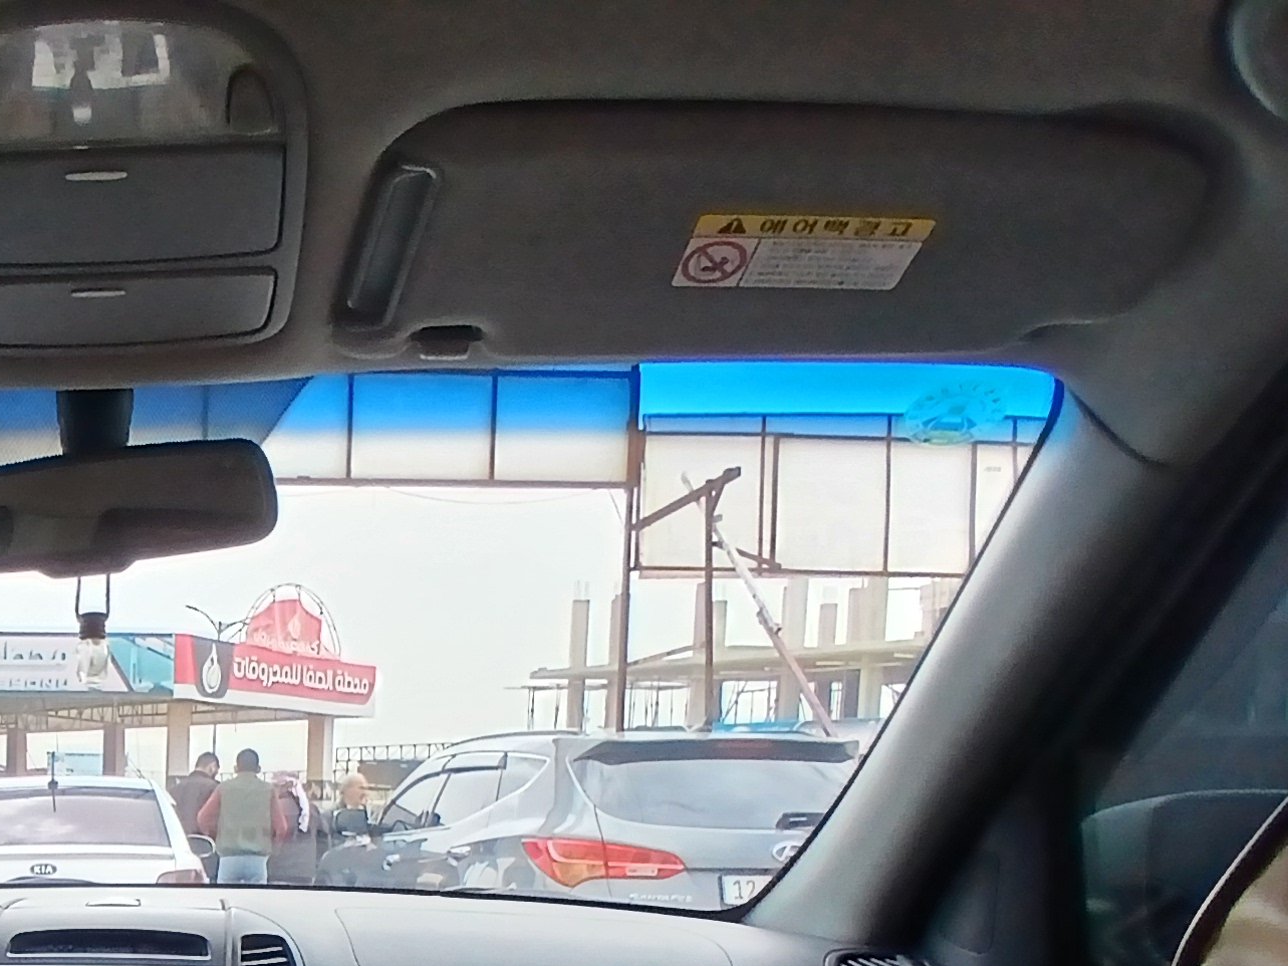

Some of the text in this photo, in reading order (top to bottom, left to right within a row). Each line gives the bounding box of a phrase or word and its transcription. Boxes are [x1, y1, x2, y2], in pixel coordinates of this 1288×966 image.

[233, 655, 370, 695] محطة الصفا للمحروقات
[33, 865, 53, 875] KIA
